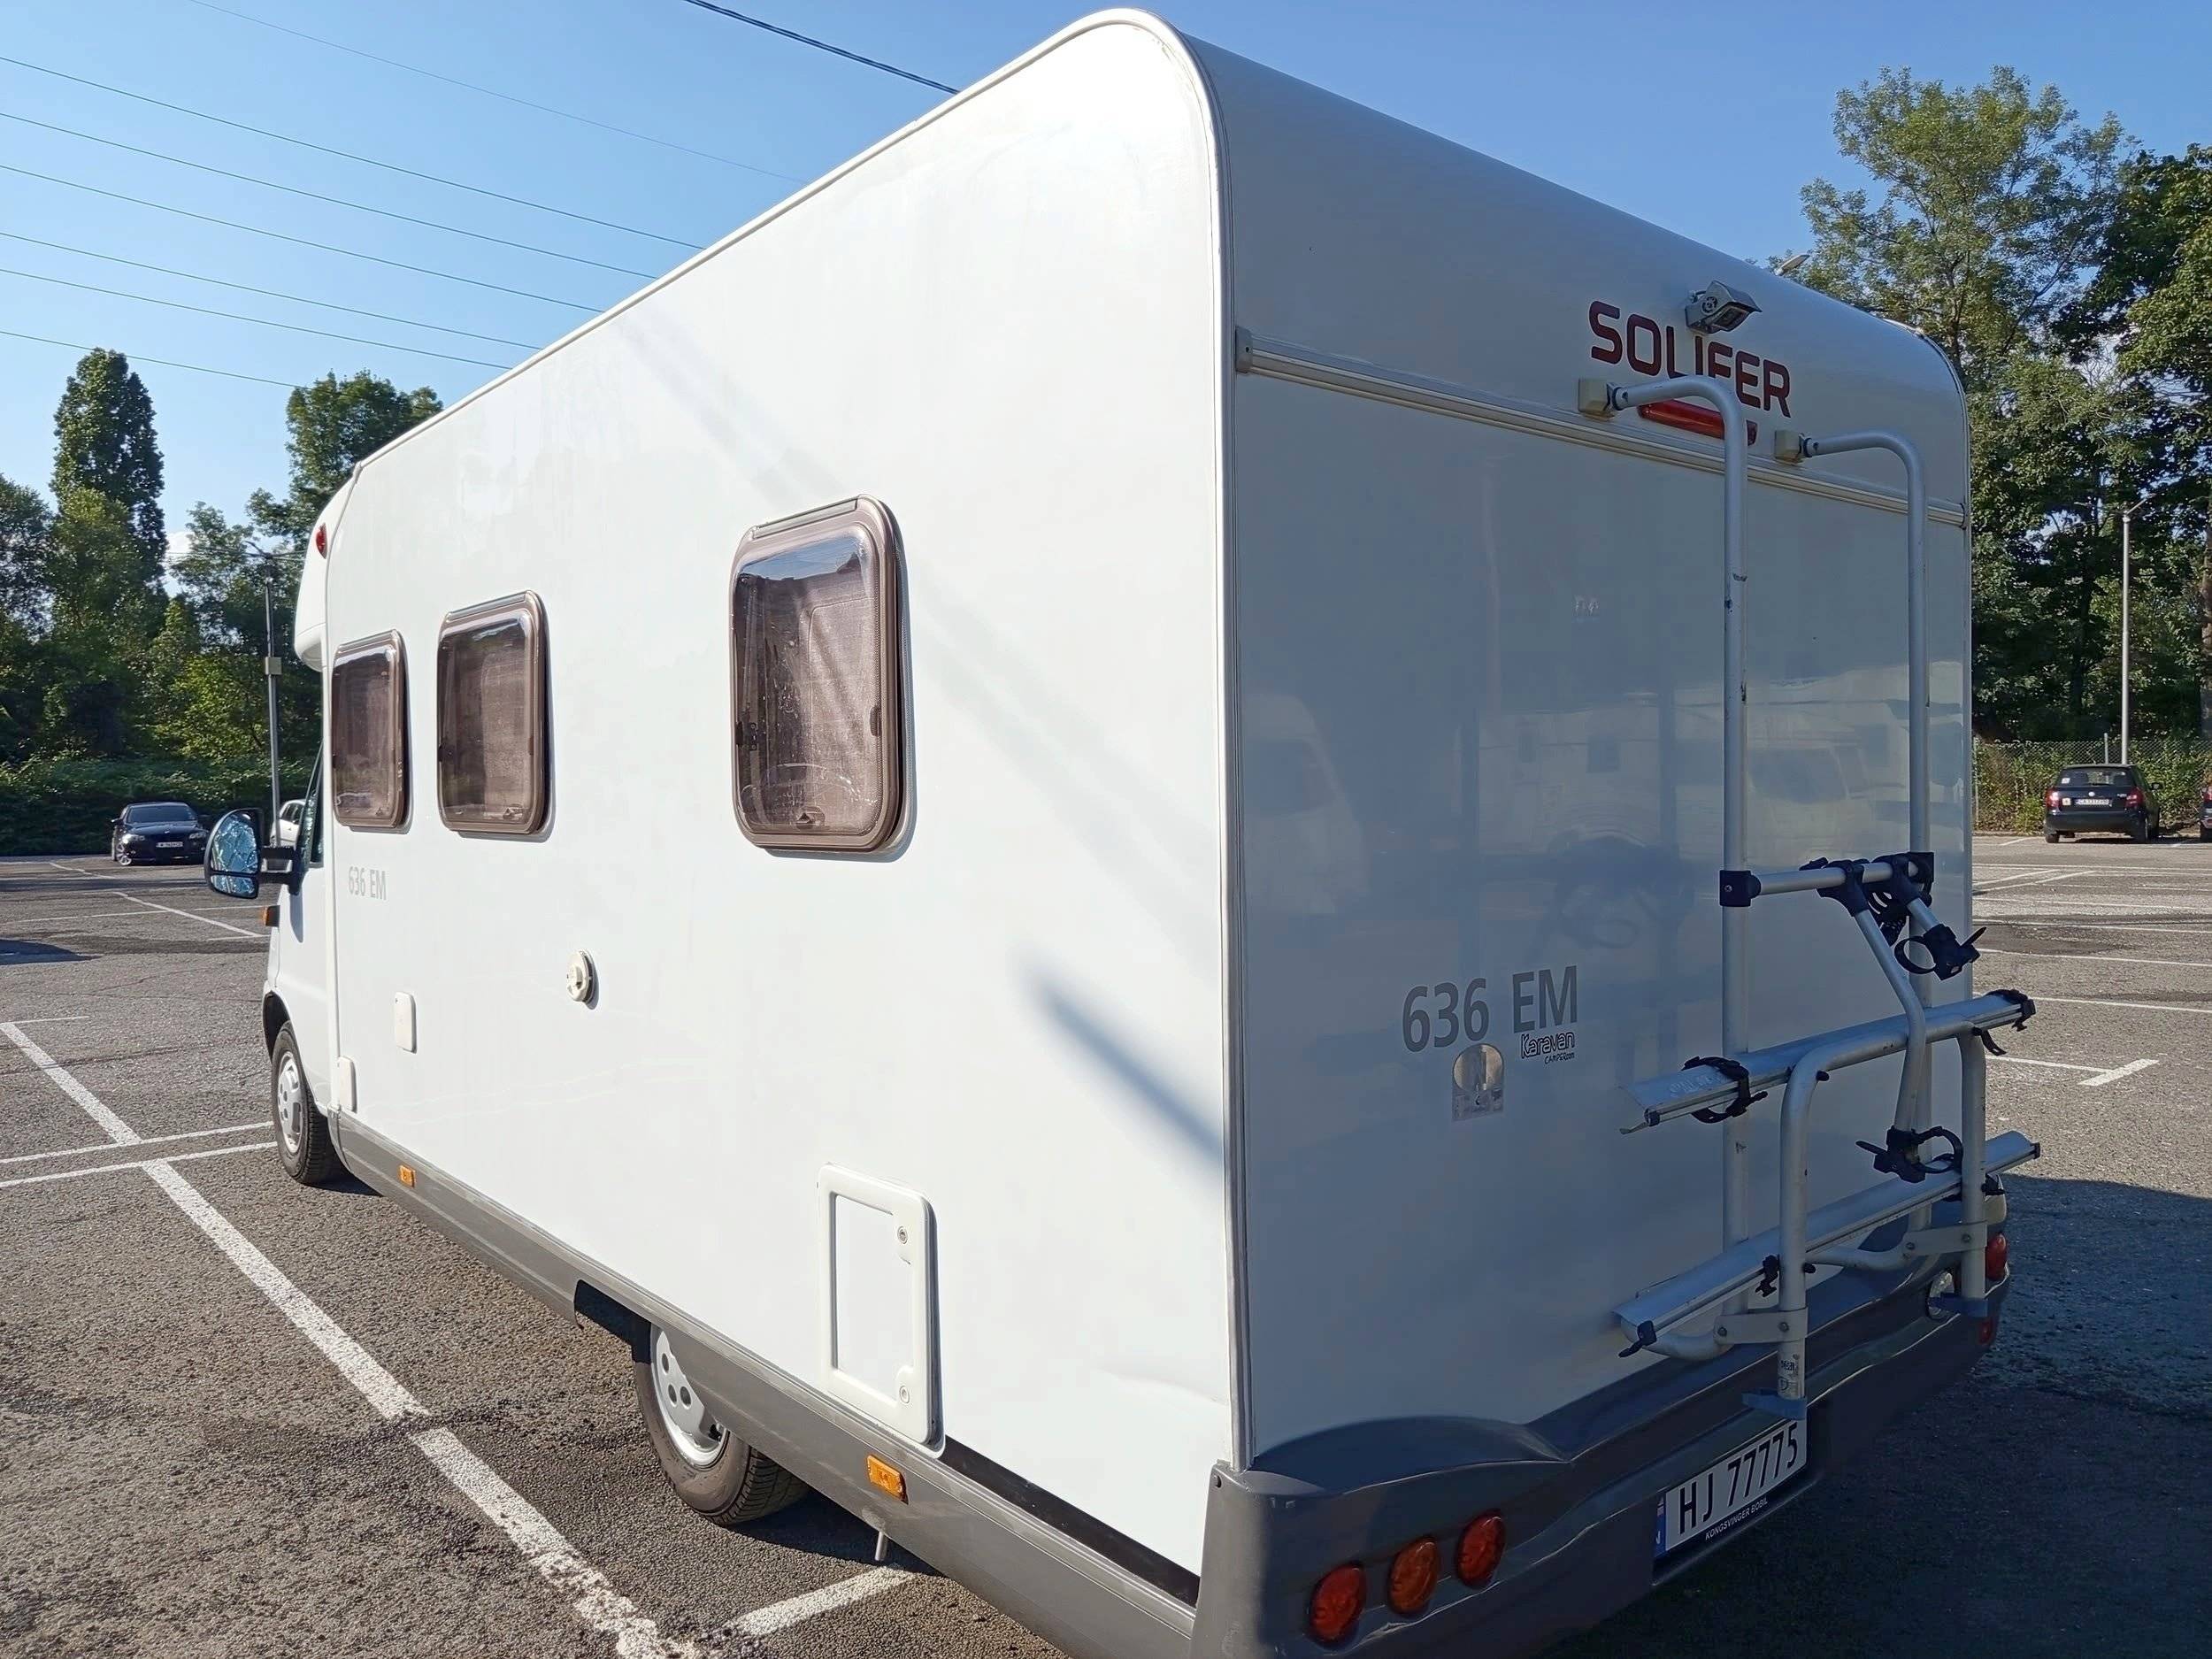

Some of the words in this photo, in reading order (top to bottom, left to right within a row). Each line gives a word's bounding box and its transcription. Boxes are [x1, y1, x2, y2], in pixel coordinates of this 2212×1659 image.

[348, 865, 366, 896] 636
[370, 869, 387, 901] EM
[1402, 978, 1490, 1052] 636
[1512, 965, 1578, 1033] EM
[1521, 1032, 1575, 1059] Karavan
[1679, 1473, 1713, 1534] HJ
[1727, 1424, 1798, 1507] 77775
[1705, 1508, 1750, 1540] KONGSVINGER
